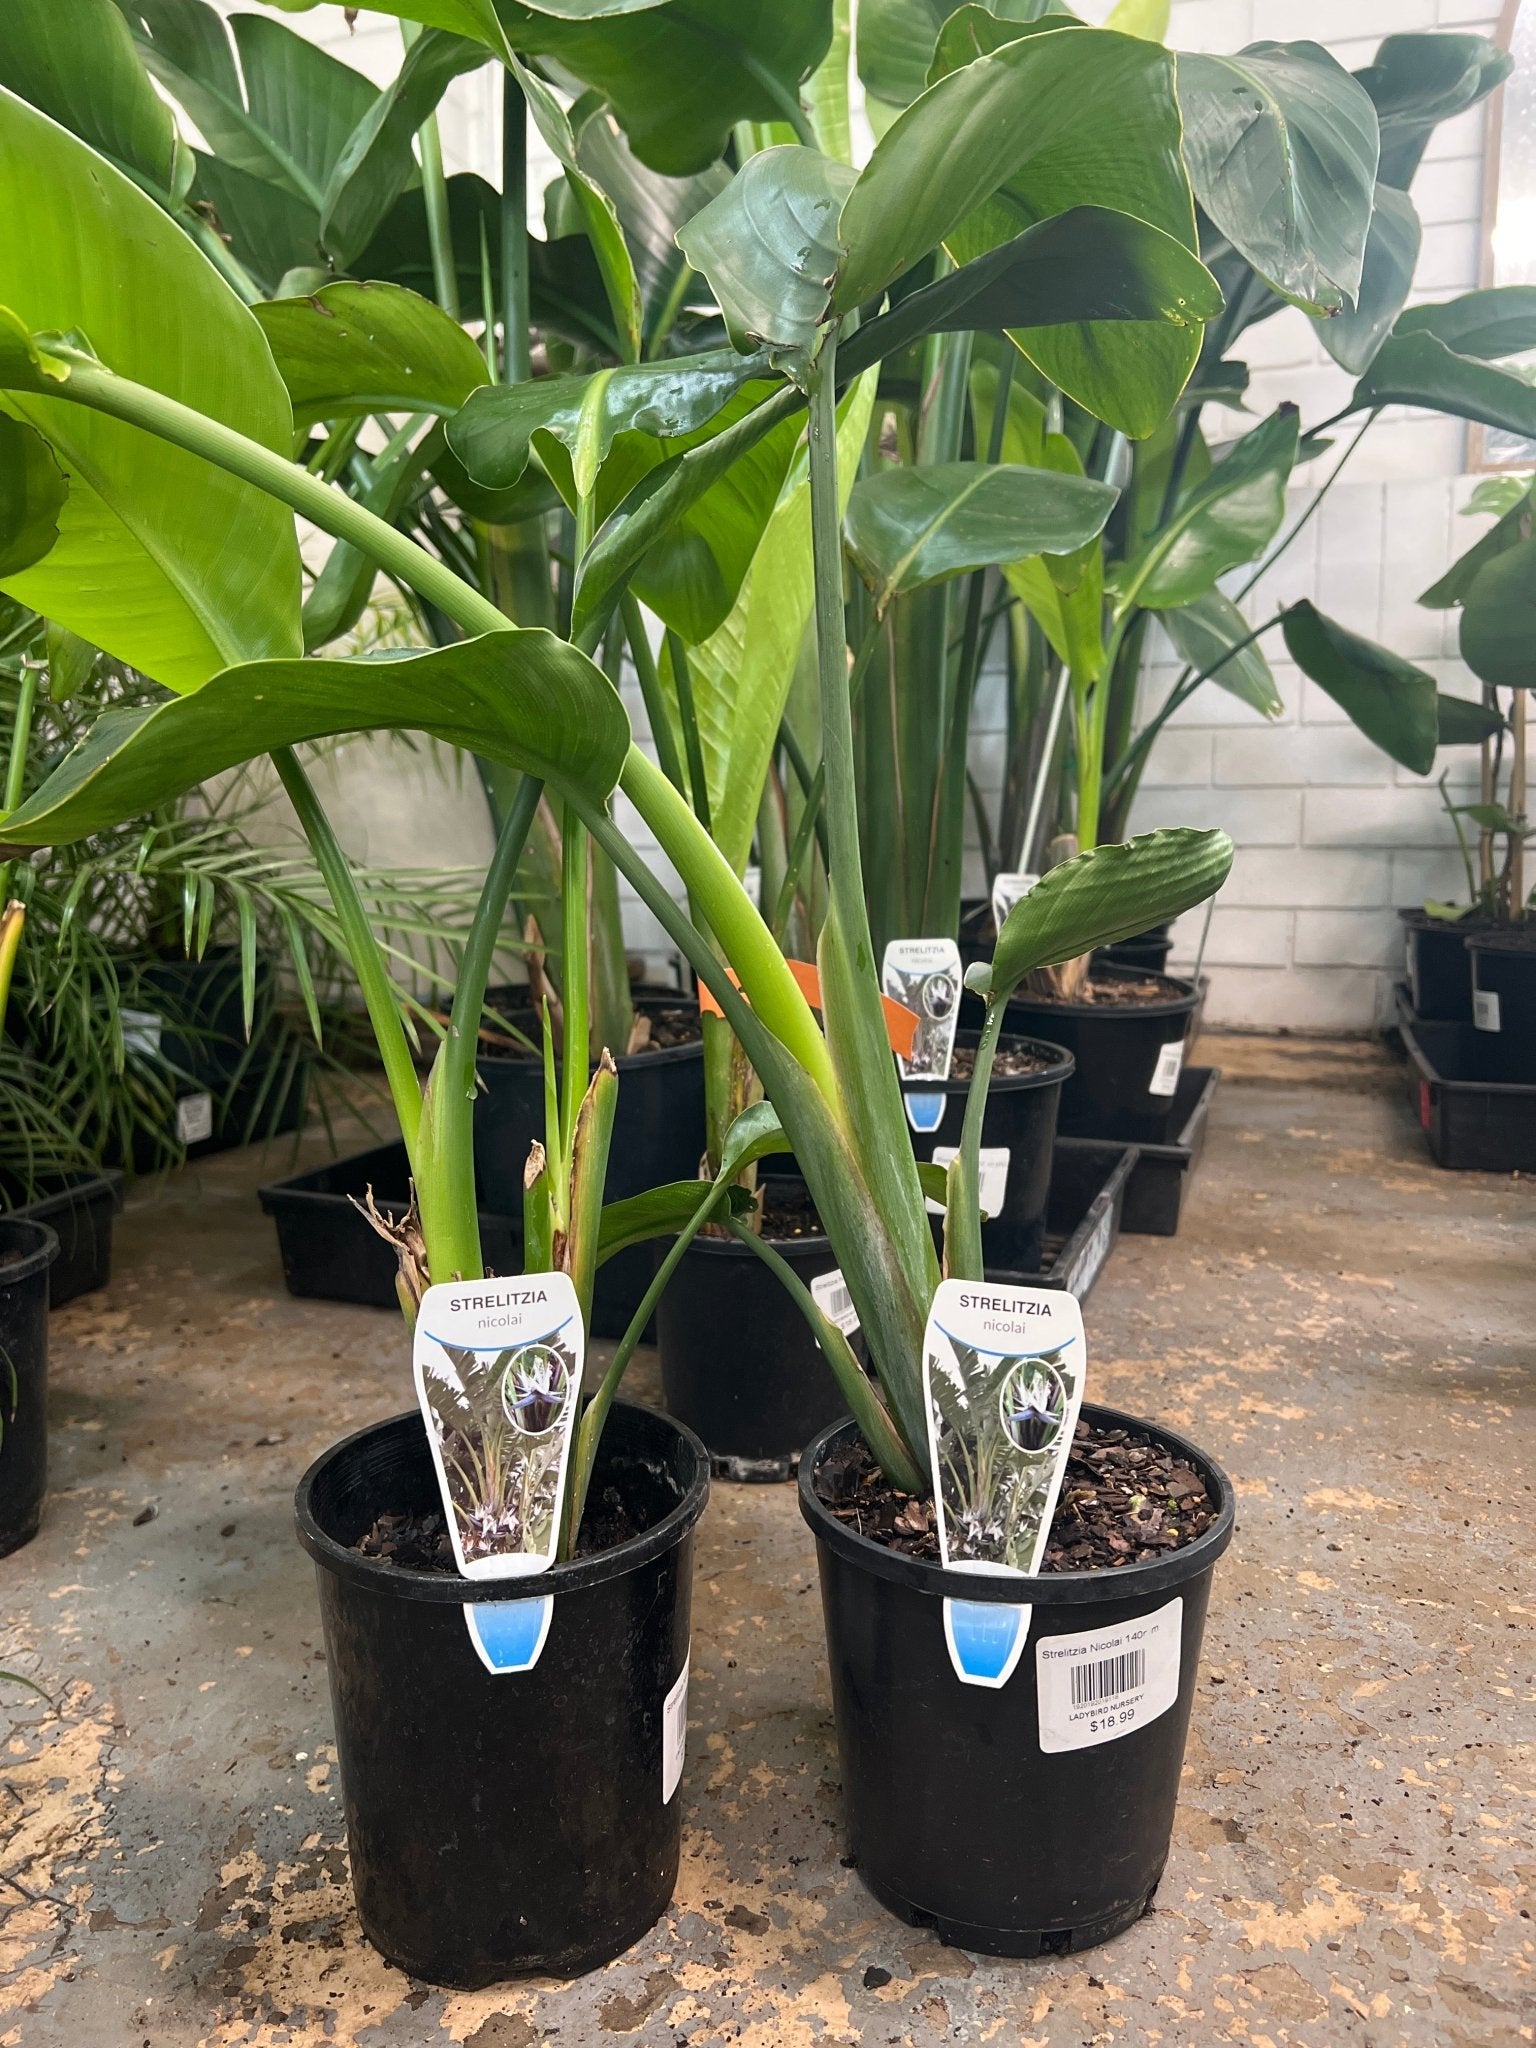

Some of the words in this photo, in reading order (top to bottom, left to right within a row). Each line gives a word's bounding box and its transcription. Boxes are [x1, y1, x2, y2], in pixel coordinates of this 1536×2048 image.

[450, 1290, 548, 1312] STRELITZIA
[960, 1294, 1052, 1317] STRELITZIA
[478, 1312, 522, 1329] nicolai
[983, 1318, 1026, 1334] nicolai
[1042, 1646, 1087, 1660] Strelitzia
[1090, 1637, 1123, 1653] Nicolai
[1069, 1706, 1109, 1721] LADYBIRD
[1111, 1693, 1145, 1711] NURSERY
[1090, 1708, 1135, 1733] $18.99
